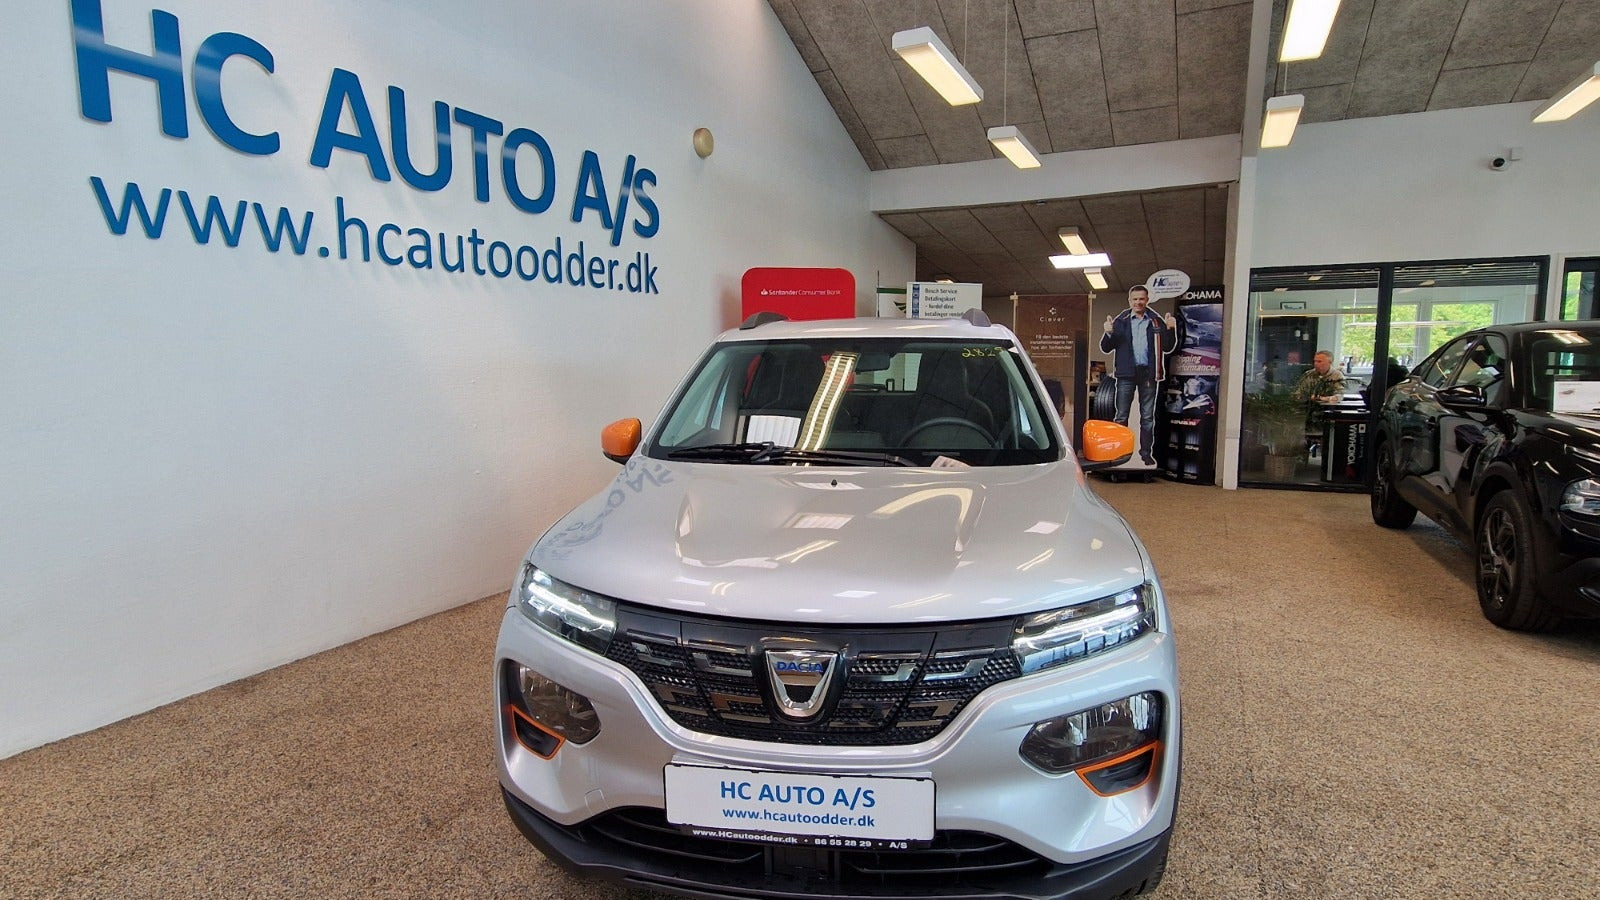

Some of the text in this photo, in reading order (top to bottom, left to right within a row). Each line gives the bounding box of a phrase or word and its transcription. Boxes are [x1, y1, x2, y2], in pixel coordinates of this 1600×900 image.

[70, 0, 660, 247] HC AUTO A/S
[90, 176, 660, 295] www.hcautoodder.dk
[1184, 290, 1222, 300] OHAMA
[1347, 423, 1358, 465] YOKOHAMA
[776, 661, 824, 673] DACIA
[720, 781, 876, 811] HC AUTO A/S
[722, 808, 875, 827] www.hcautoodder.dk
[692, 829, 798, 844] www.HCautoodder.dk
[844, 839, 857, 847] 28
[889, 841, 908, 849] A/S
